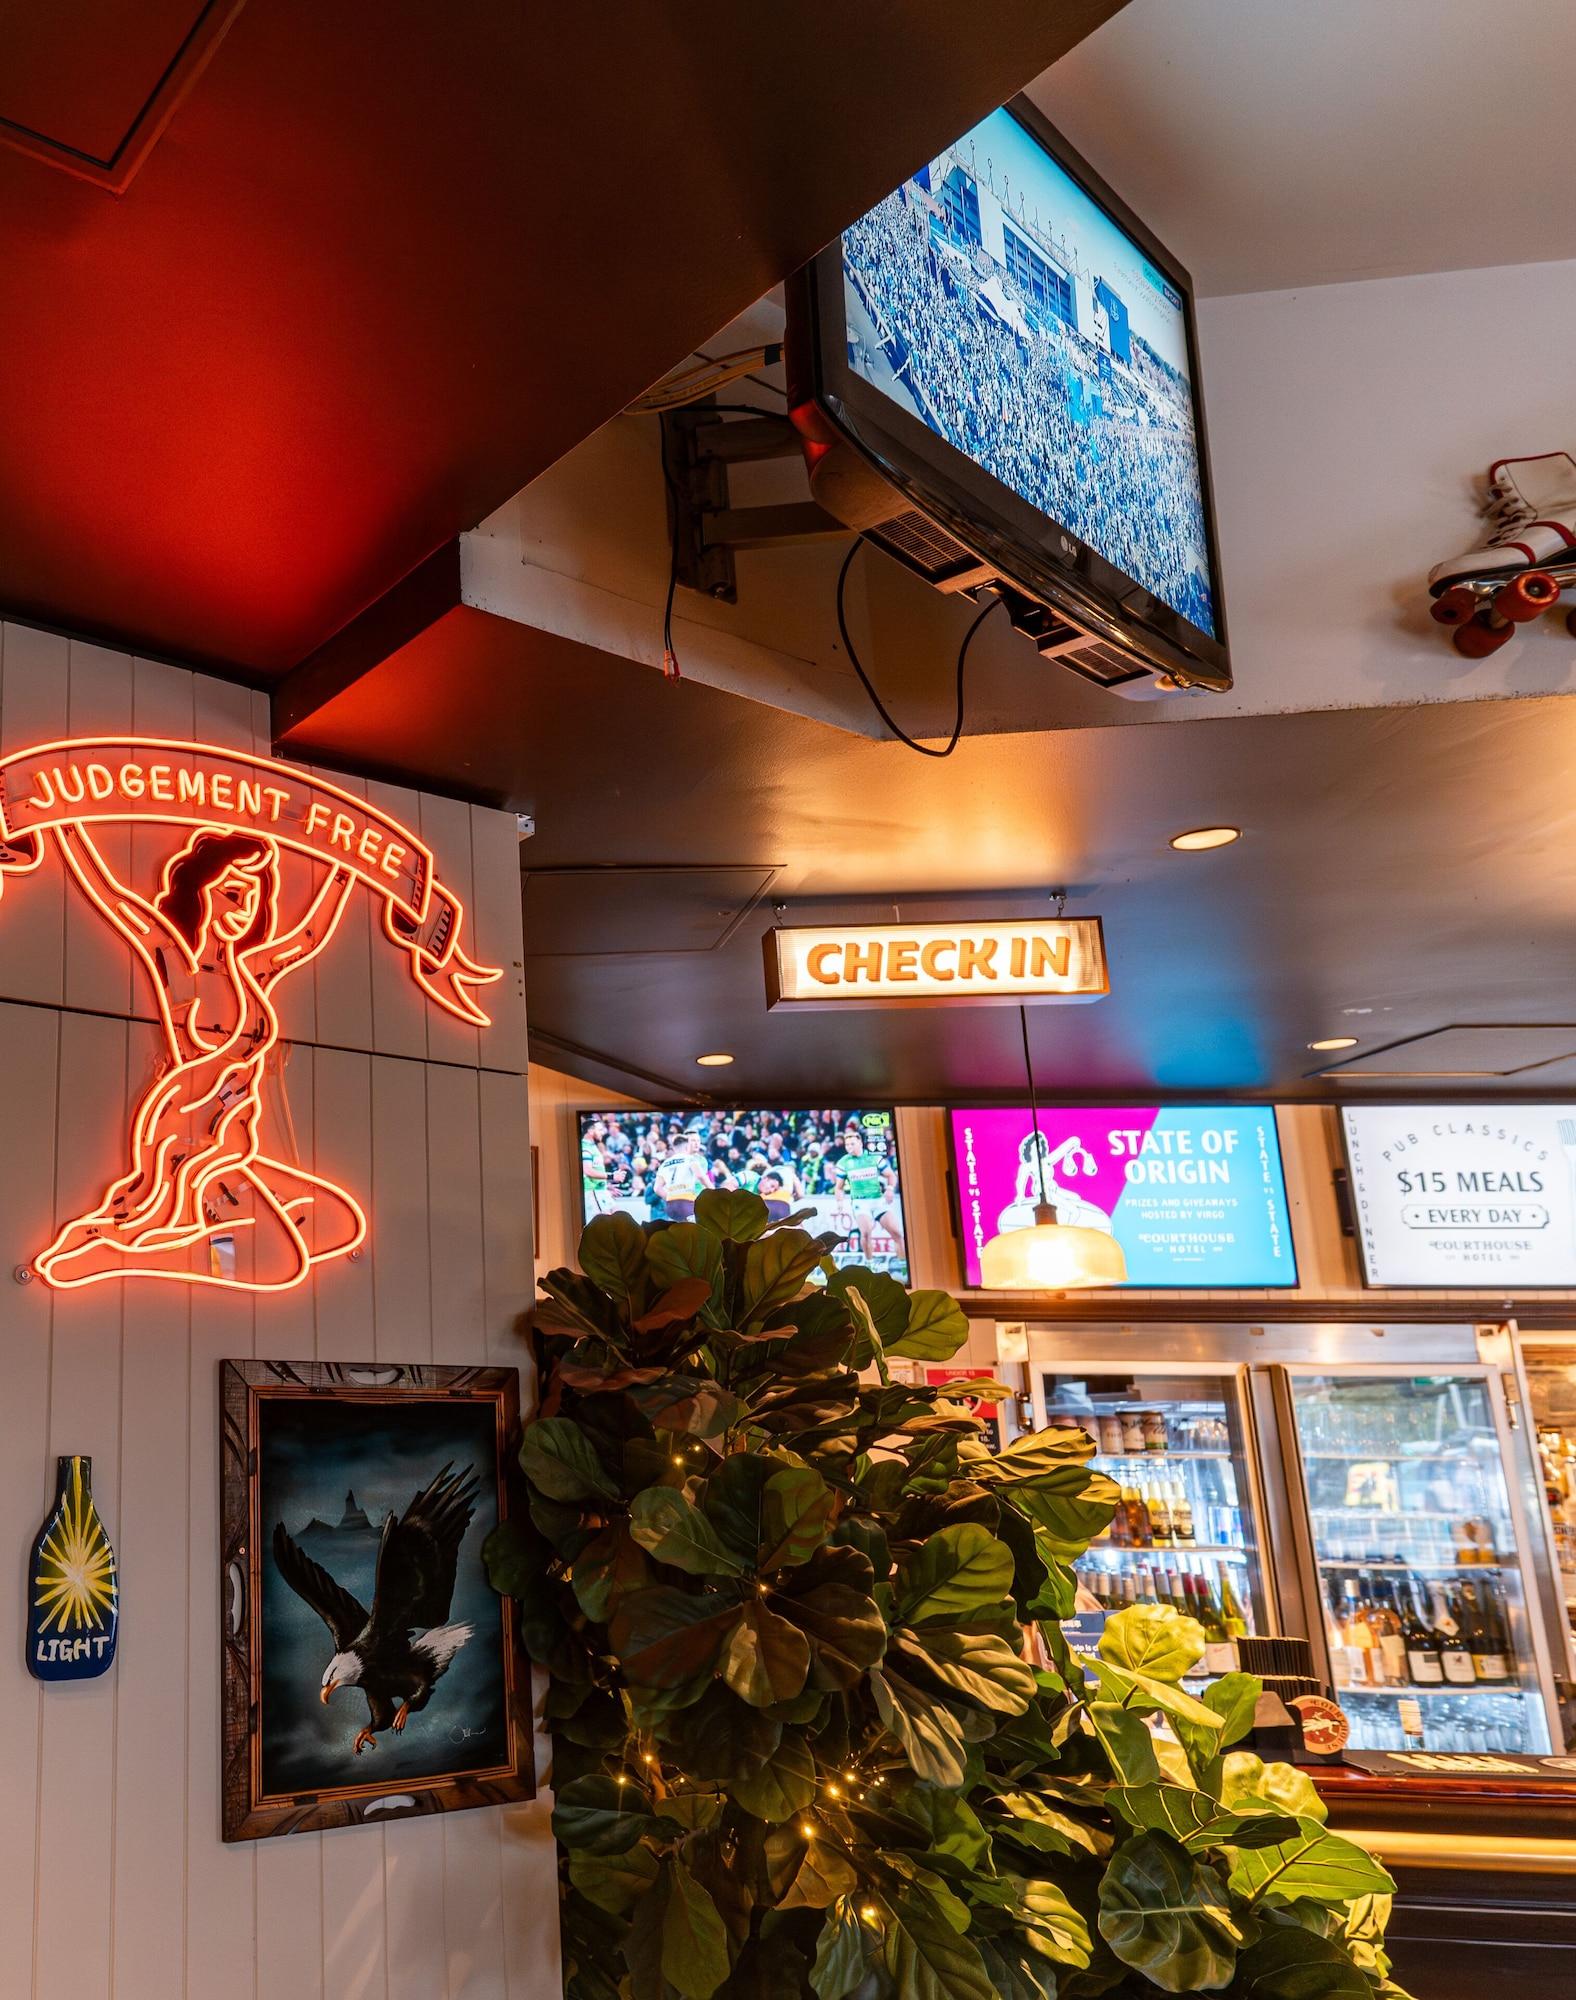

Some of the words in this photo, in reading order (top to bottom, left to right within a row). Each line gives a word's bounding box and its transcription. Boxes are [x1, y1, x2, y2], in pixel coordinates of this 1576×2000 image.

[29, 763, 291, 822] JUDGEMENT
[305, 802, 407, 879] FREE
[806, 938, 999, 985] CHECK
[1009, 936, 1072, 979] IN
[1107, 1130, 1193, 1155] STATE
[1201, 1129, 1239, 1155] OF
[1382, 1133, 1419, 1163] PUB
[1432, 1123, 1549, 1162] CLASSICS
[964, 1127, 978, 1186] STATE
[1124, 1159, 1231, 1184] ORIGIN
[1397, 1168, 1447, 1196] $15
[1457, 1171, 1545, 1193] MEALS
[1125, 1198, 1159, 1208] PRIZES
[1161, 1198, 1180, 1207] AND
[1183, 1198, 1239, 1207] GIVEAWAYS
[1256, 1125, 1272, 1183] STATE
[1267, 1199, 1281, 1258] STATE
[1347, 1113, 1364, 1175] LUNCH
[1361, 1200, 1380, 1278] DINNER
[1141, 1209, 1178, 1219] HOSTED
[1180, 1209, 1193, 1219] BY
[1196, 1209, 1225, 1219] VIRGO
[1428, 1208, 1482, 1223] EVERY
[1488, 1208, 1523, 1223] DAY
[1143, 1232, 1235, 1244] COURTHOUSE
[1169, 1245, 1206, 1254] HOTEL
[1433, 1239, 1533, 1251] COURTHOUSE
[1463, 1253, 1502, 1262] HOTEL
[36, 1634, 111, 1664] LIGHT
